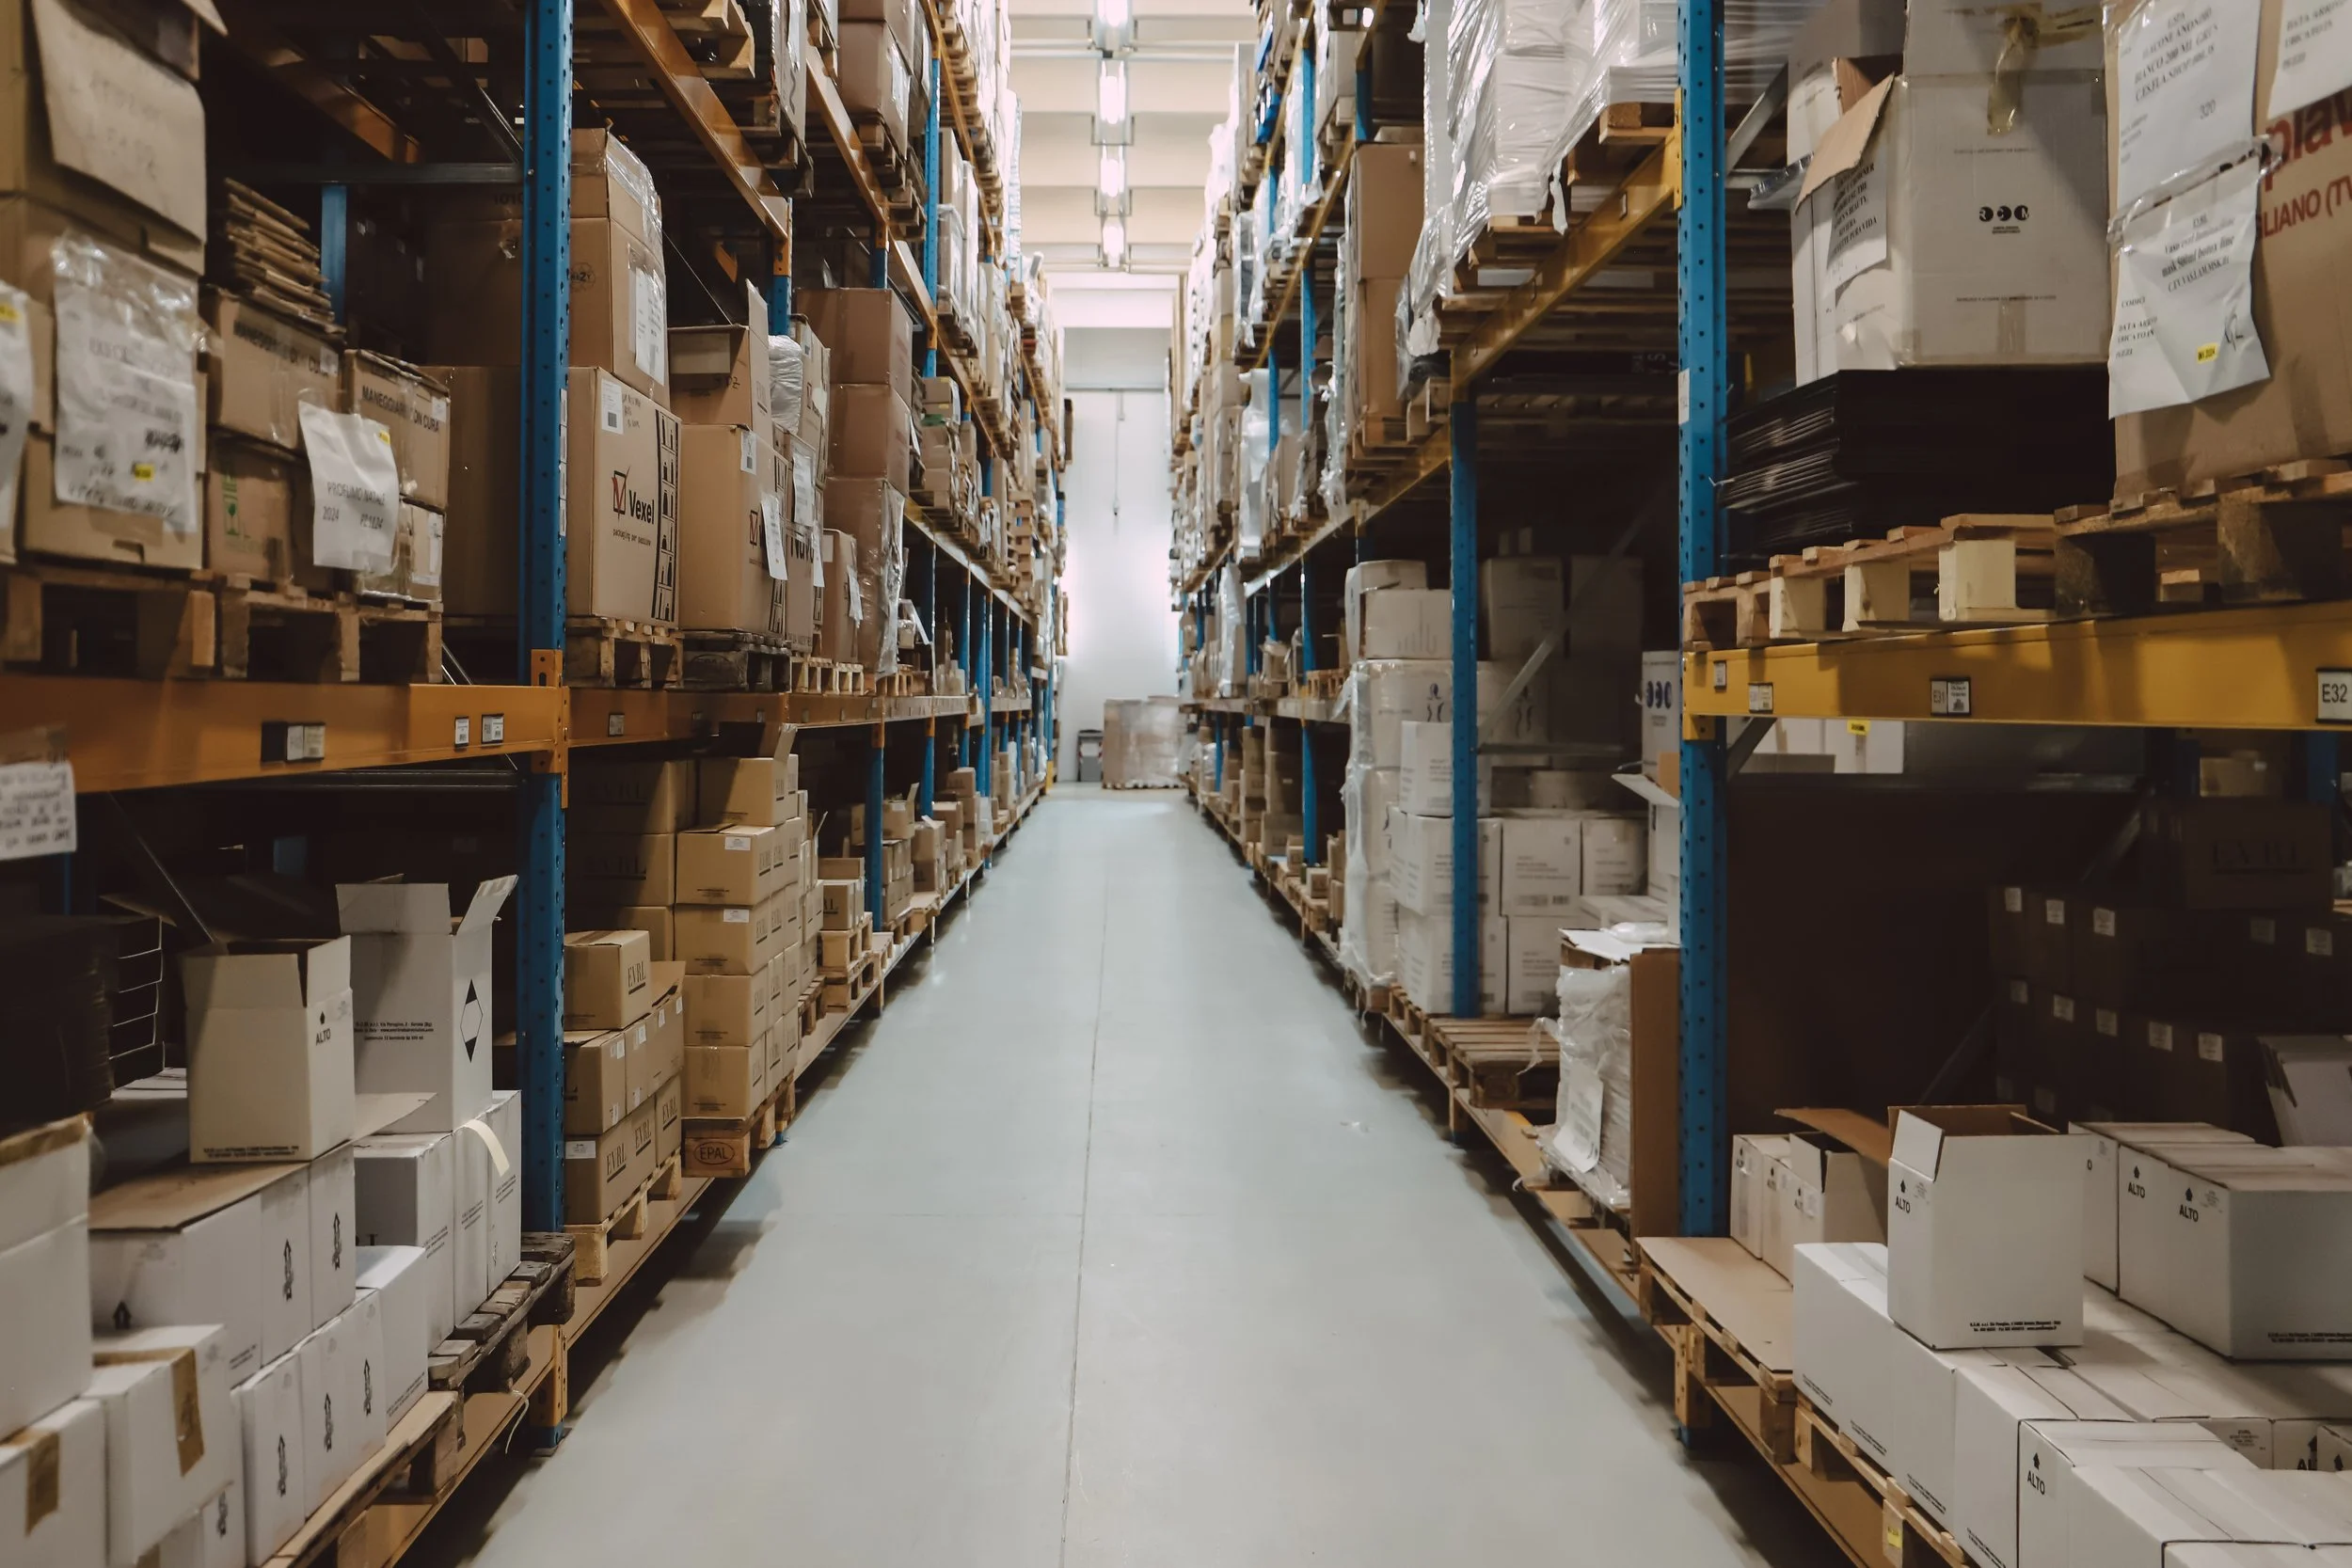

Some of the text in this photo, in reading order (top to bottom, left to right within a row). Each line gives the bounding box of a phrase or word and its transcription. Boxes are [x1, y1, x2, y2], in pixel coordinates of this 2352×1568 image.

[2260, 188, 2322, 239] LIANO
[628, 489, 655, 525] Vexel
[2322, 683, 2348, 704] E32
[628, 961, 646, 988] EVRL
[315, 1027, 331, 1046] ALTO
[662, 1097, 677, 1124] EVRL
[634, 1118, 652, 1149] EVRL
[606, 1142, 627, 1176] EVRL
[699, 1146, 728, 1161] EPAL
[2127, 1181, 2146, 1198] ALTO
[1895, 1196, 1911, 1214] ALTO
[2179, 1204, 2199, 1223] ALTO
[2027, 1470, 2045, 1496] ALTO
